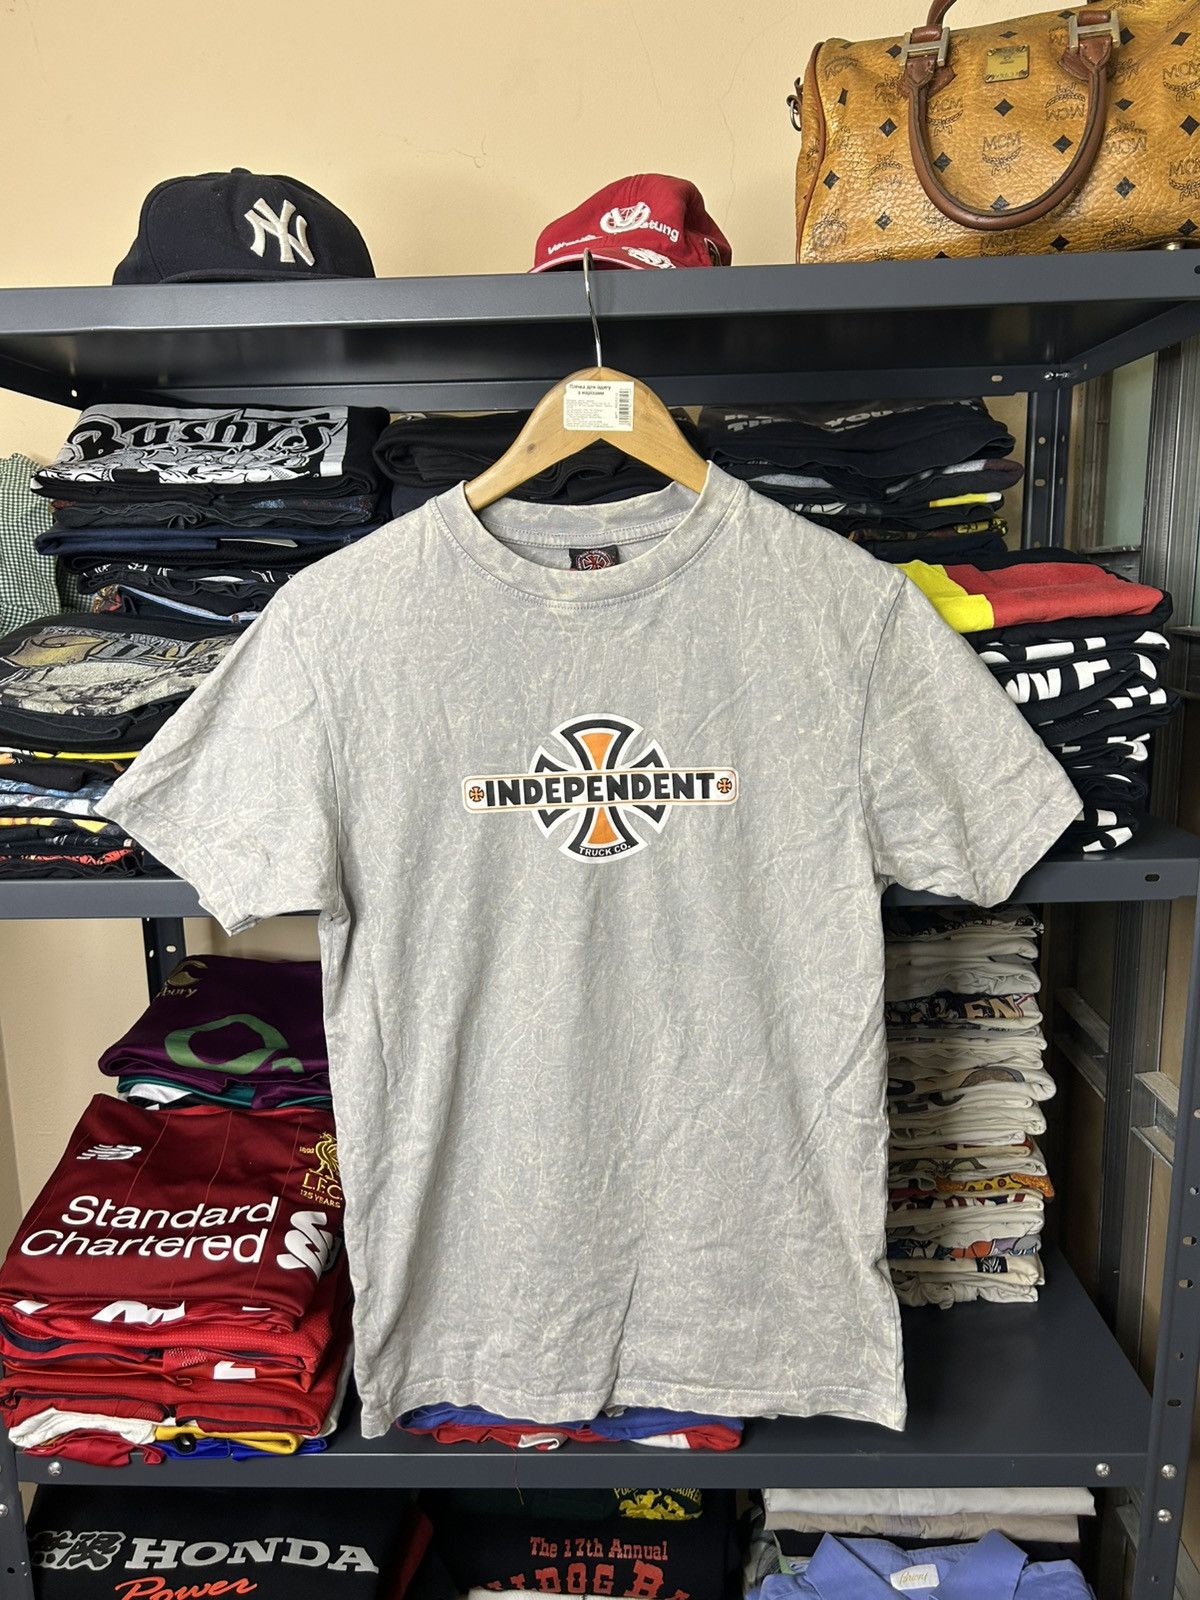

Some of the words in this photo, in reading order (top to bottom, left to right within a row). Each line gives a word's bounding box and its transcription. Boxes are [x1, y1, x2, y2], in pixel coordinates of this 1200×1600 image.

[982, 132, 1022, 152] MCM
[244, 197, 315, 267] NY
[485, 772, 715, 807] INDEPENDENT
[579, 846, 612, 857] TRUCK
[614, 842, 631, 853] CO.
[61, 1194, 280, 1230] Standard
[314, 1193, 342, 1209] YEARS
[20, 1228, 268, 1264] Chartered
[124, 1536, 380, 1574] HONDA
[529, 1536, 559, 1559] The
[608, 1537, 669, 1561] Annual
